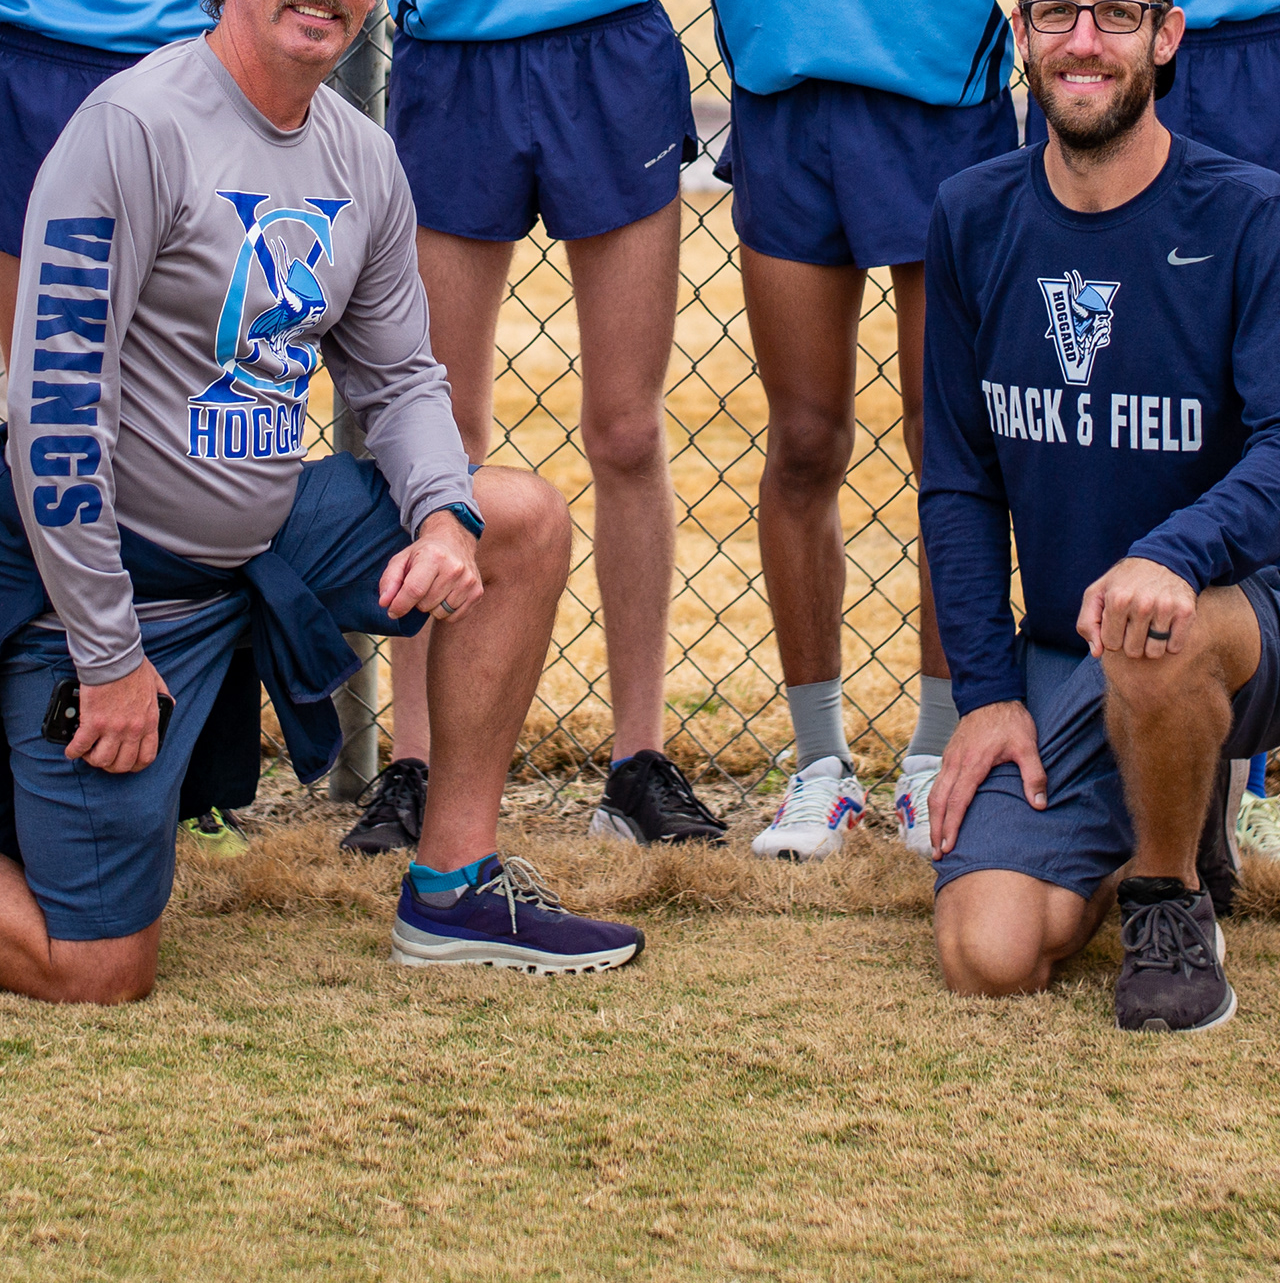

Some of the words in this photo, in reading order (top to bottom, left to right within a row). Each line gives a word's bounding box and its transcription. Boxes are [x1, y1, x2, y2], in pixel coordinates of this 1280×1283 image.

[1053, 290, 1078, 363] HOGGARD
[30, 216, 116, 527] VIKINGS
[982, 380, 1068, 443] TRACK
[1077, 393, 1093, 446] &
[1111, 393, 1202, 451] FIELD
